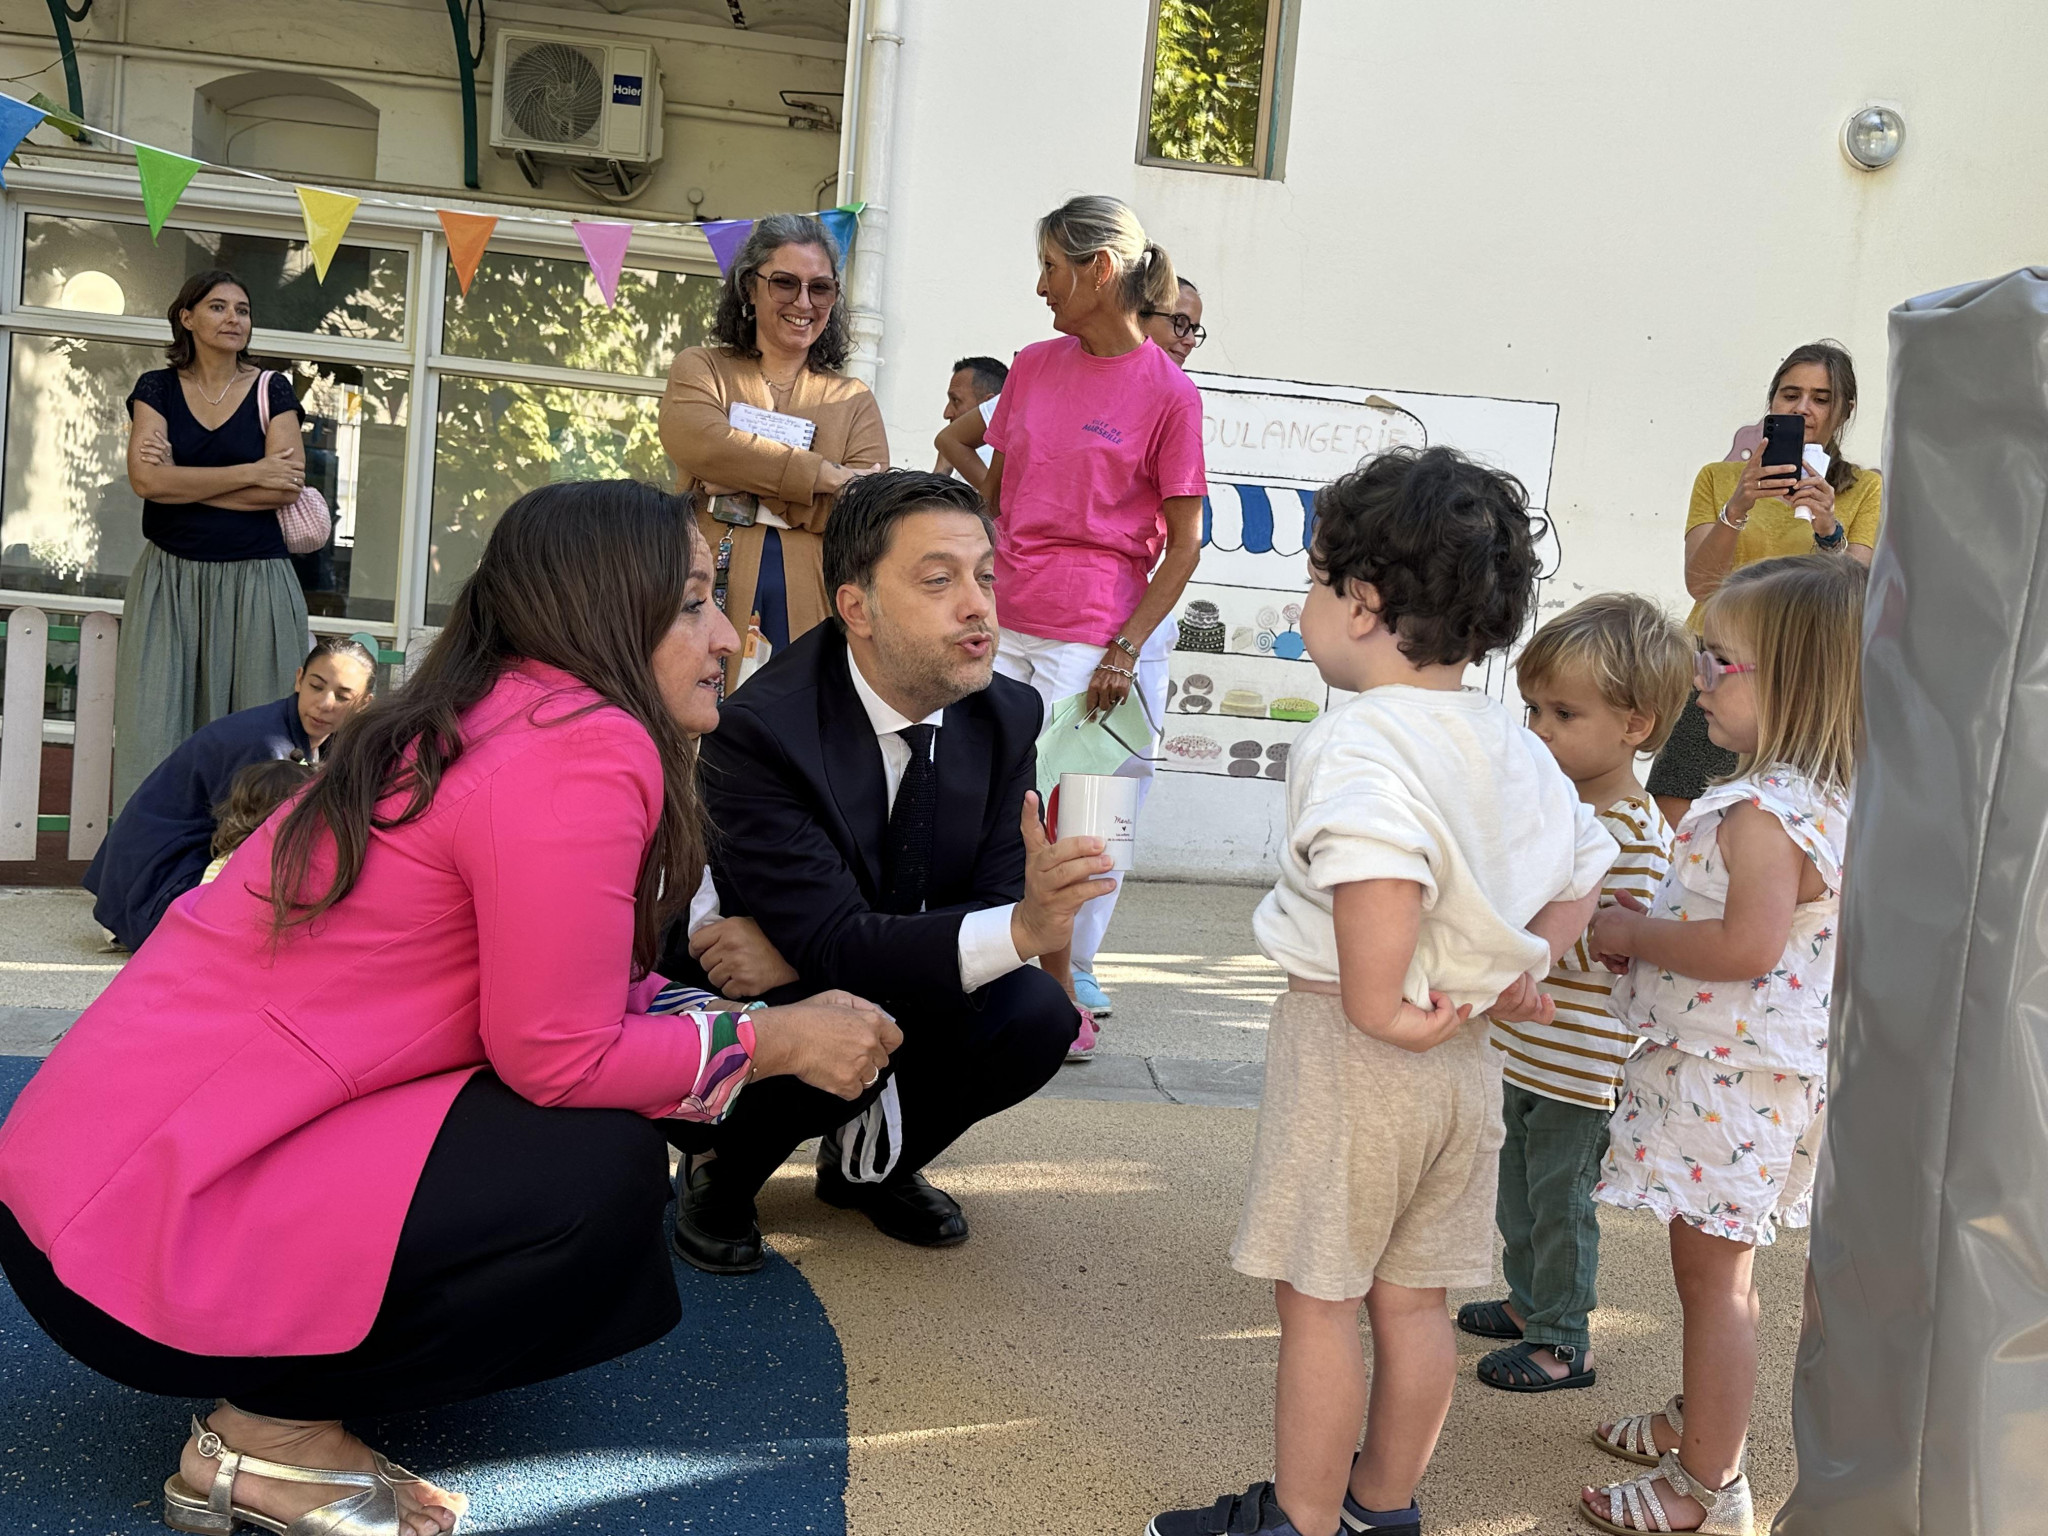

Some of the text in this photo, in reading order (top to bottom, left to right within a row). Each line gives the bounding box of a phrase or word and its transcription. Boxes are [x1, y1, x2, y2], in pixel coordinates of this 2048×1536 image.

[613, 84, 641, 97] Haier
[1081, 423, 1123, 445] MARSEILLE
[1110, 427, 1122, 436] DE
